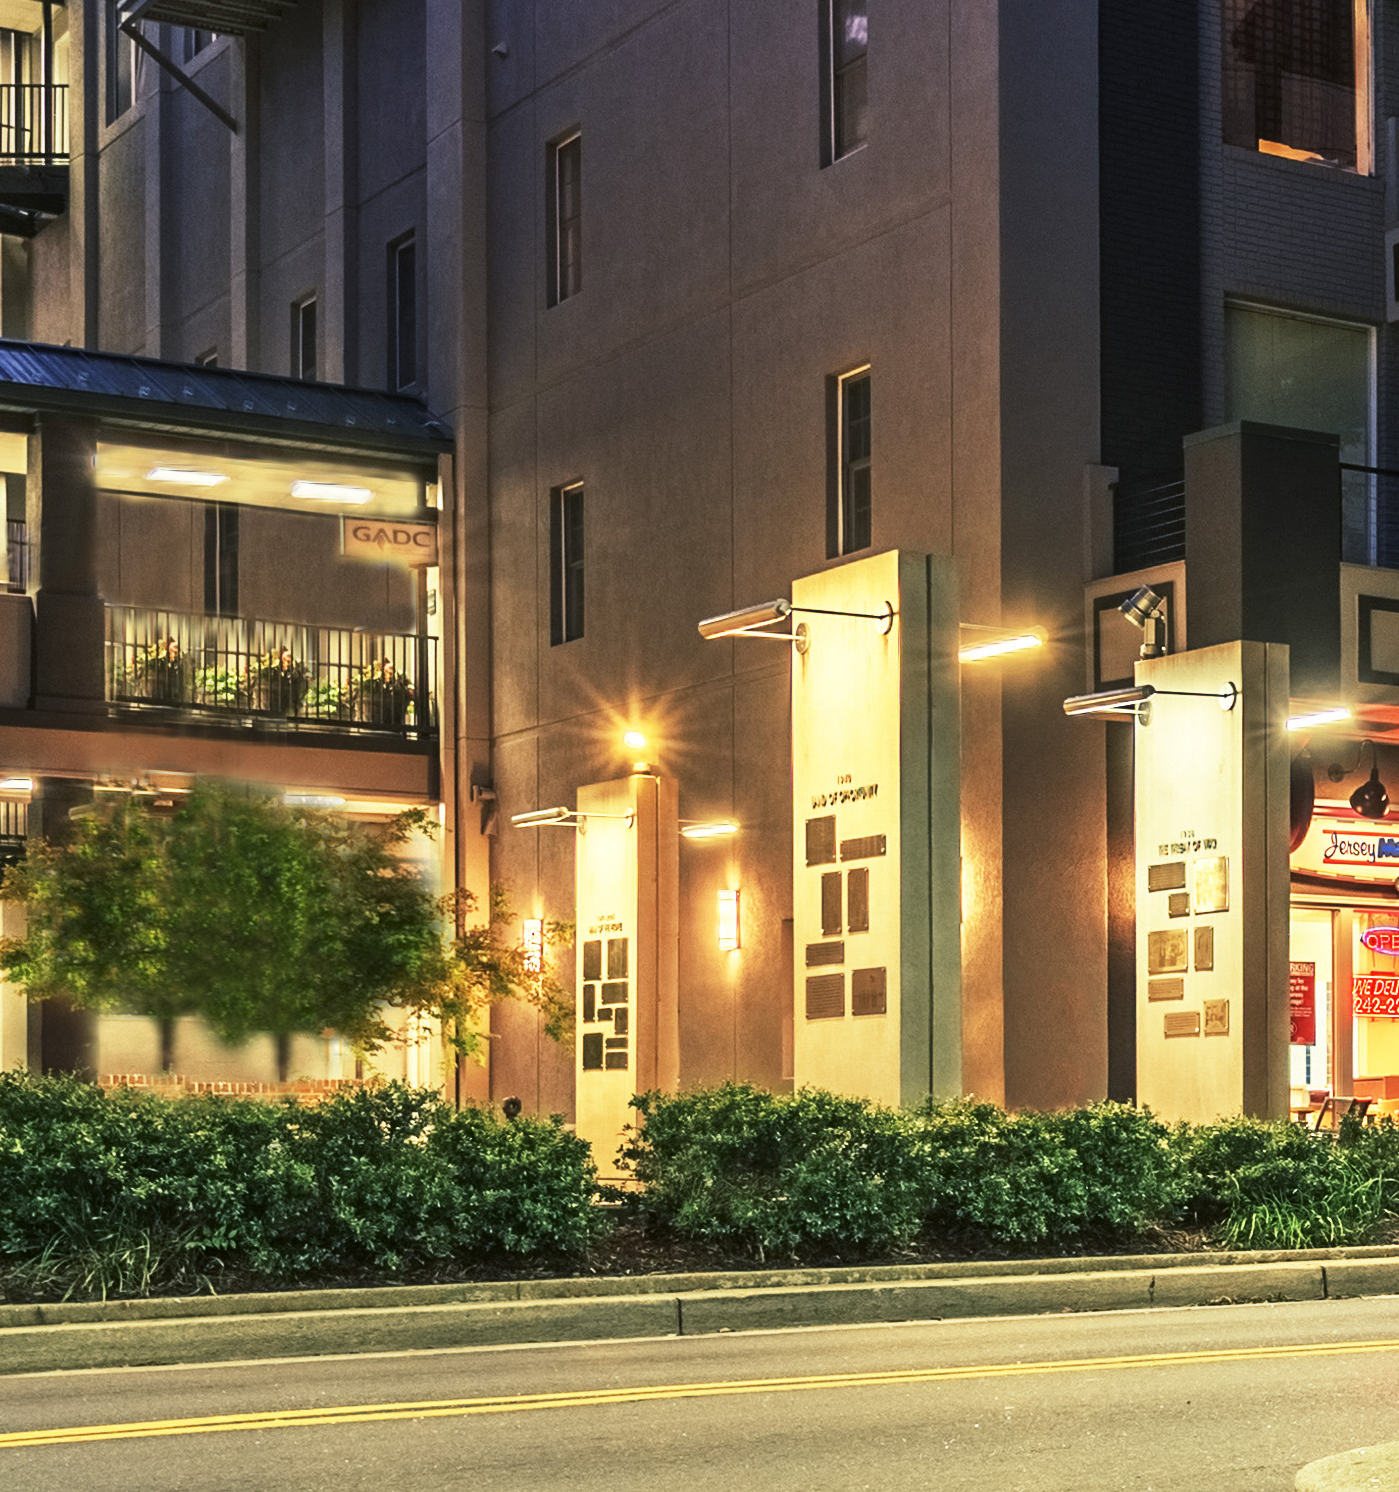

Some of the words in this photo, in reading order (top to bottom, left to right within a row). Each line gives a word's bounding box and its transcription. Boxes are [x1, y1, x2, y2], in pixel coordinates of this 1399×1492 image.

[352, 526, 431, 548] GADC
[1323, 831, 1376, 863] Jersey
[1352, 979, 1373, 995] WE
